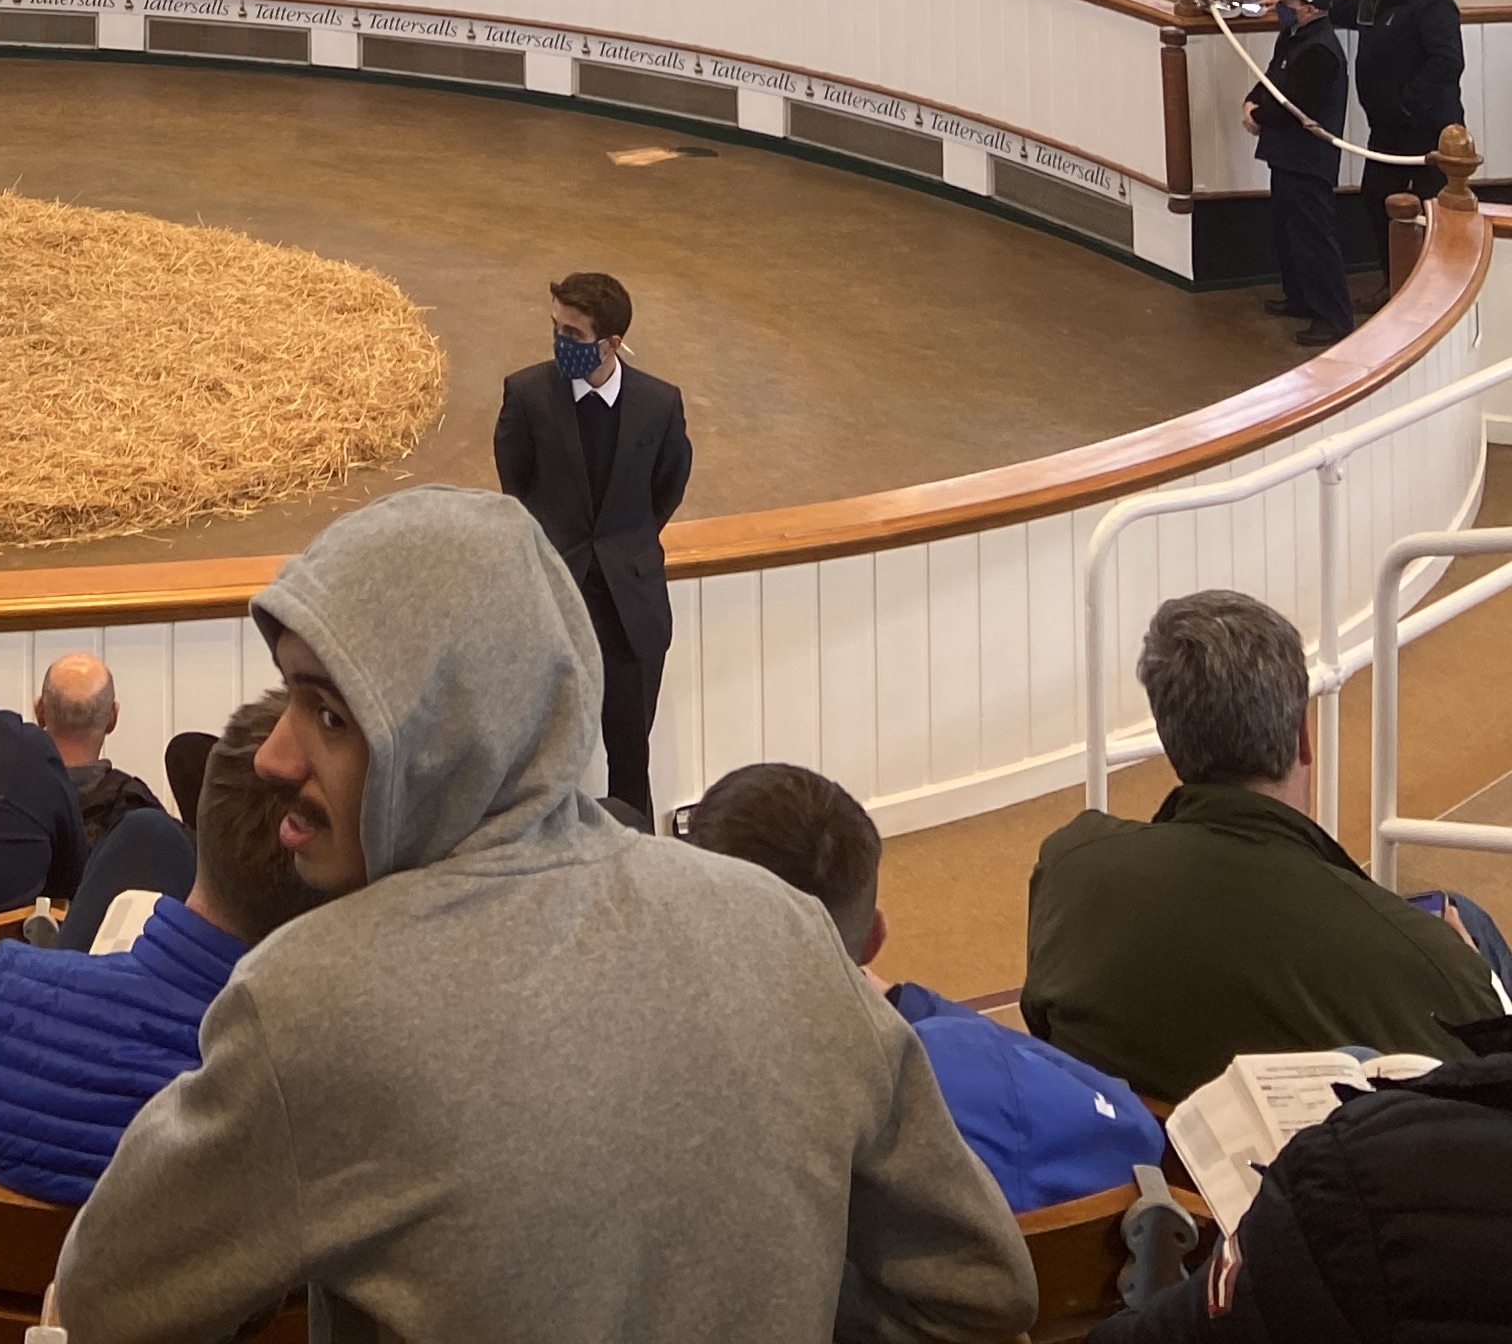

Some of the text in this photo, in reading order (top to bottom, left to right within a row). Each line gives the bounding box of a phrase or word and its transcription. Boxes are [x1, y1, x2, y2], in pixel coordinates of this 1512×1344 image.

[254, 3, 343, 28] Tattersalls
[369, 12, 458, 39] Tattersalls
[485, 24, 574, 52] Tattersalls
[598, 41, 686, 71] Tattersalls
[710, 60, 797, 94] Tattersalls
[822, 83, 907, 121] Tattersalls
[930, 112, 1013, 154] Tattersalls
[1033, 144, 1112, 191] Tattersalls
